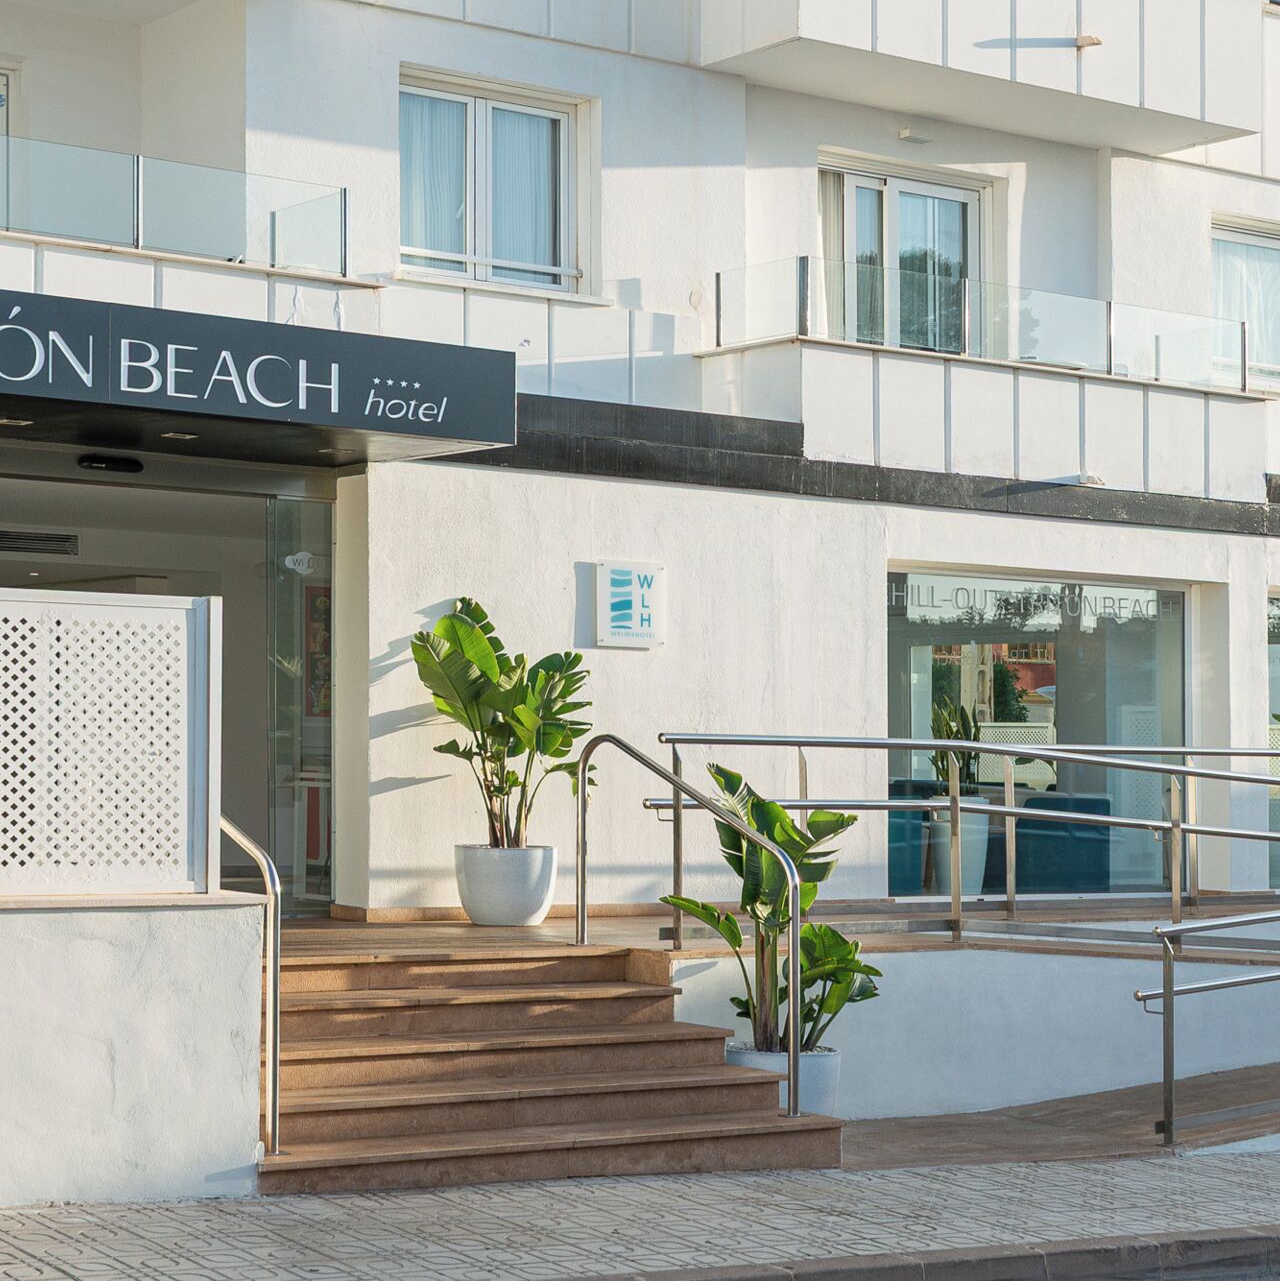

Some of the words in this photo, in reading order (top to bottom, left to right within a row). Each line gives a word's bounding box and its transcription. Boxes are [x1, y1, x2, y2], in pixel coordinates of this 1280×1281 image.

[119, 338, 340, 414] BEACH
[363, 389, 448, 423] hotel
[887, 582, 1006, 614] HILL-OUT
